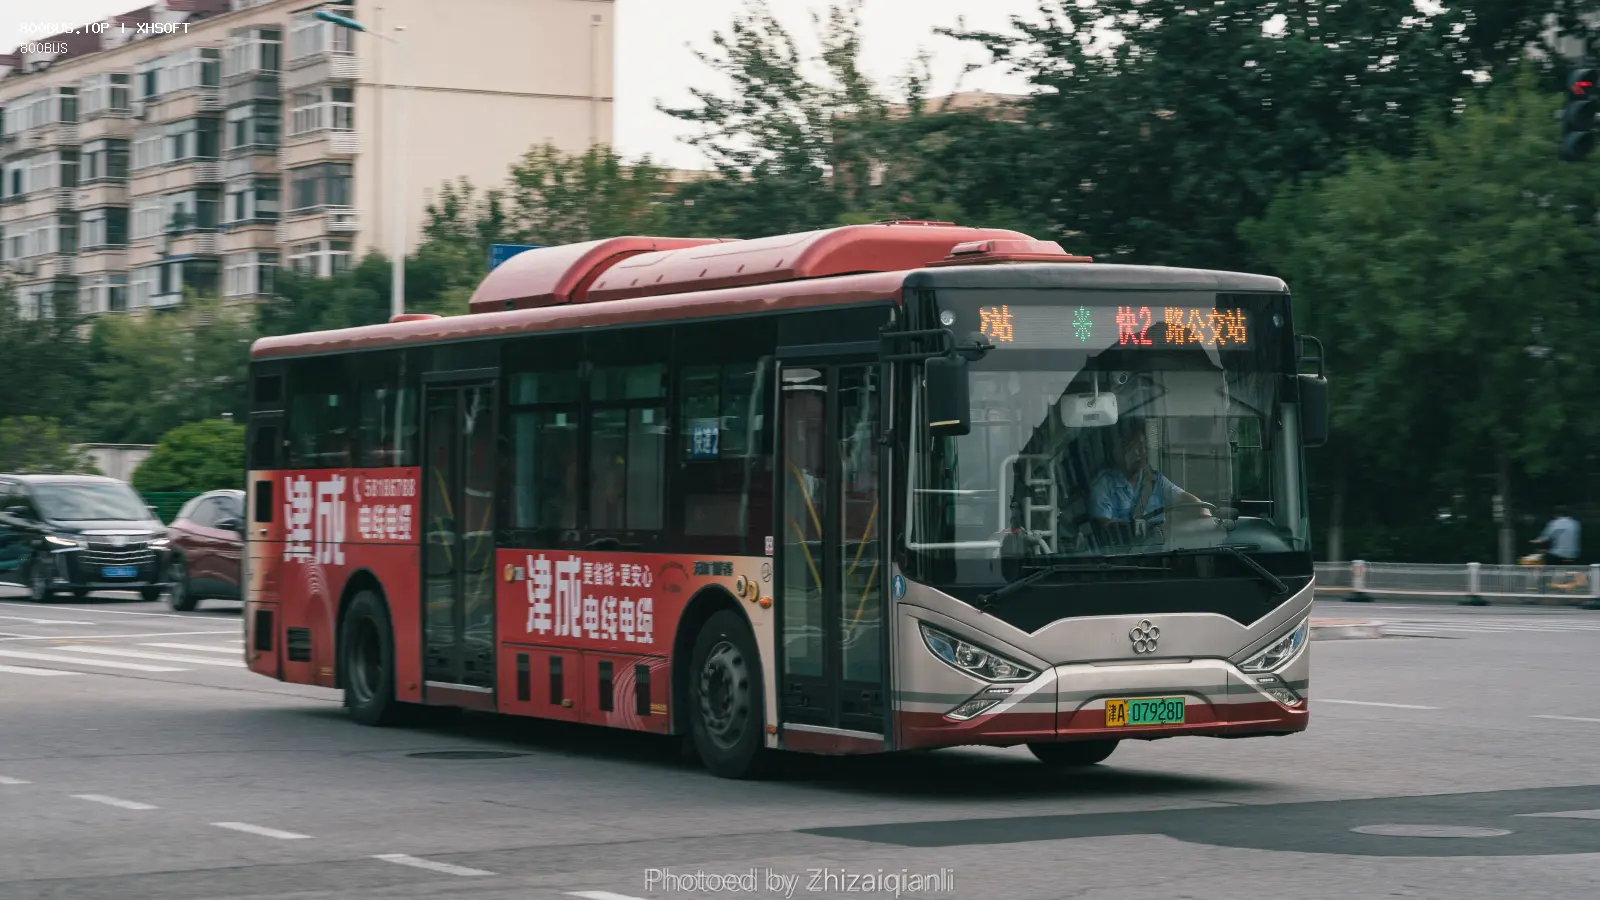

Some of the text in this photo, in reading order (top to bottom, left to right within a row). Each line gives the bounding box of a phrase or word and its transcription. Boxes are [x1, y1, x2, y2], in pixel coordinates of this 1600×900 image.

[1164, 306, 1247, 345] 路公交站
[284, 474, 346, 565] 津成
[526, 553, 582, 638] 津成
[583, 594, 654, 644] 电线电缆
